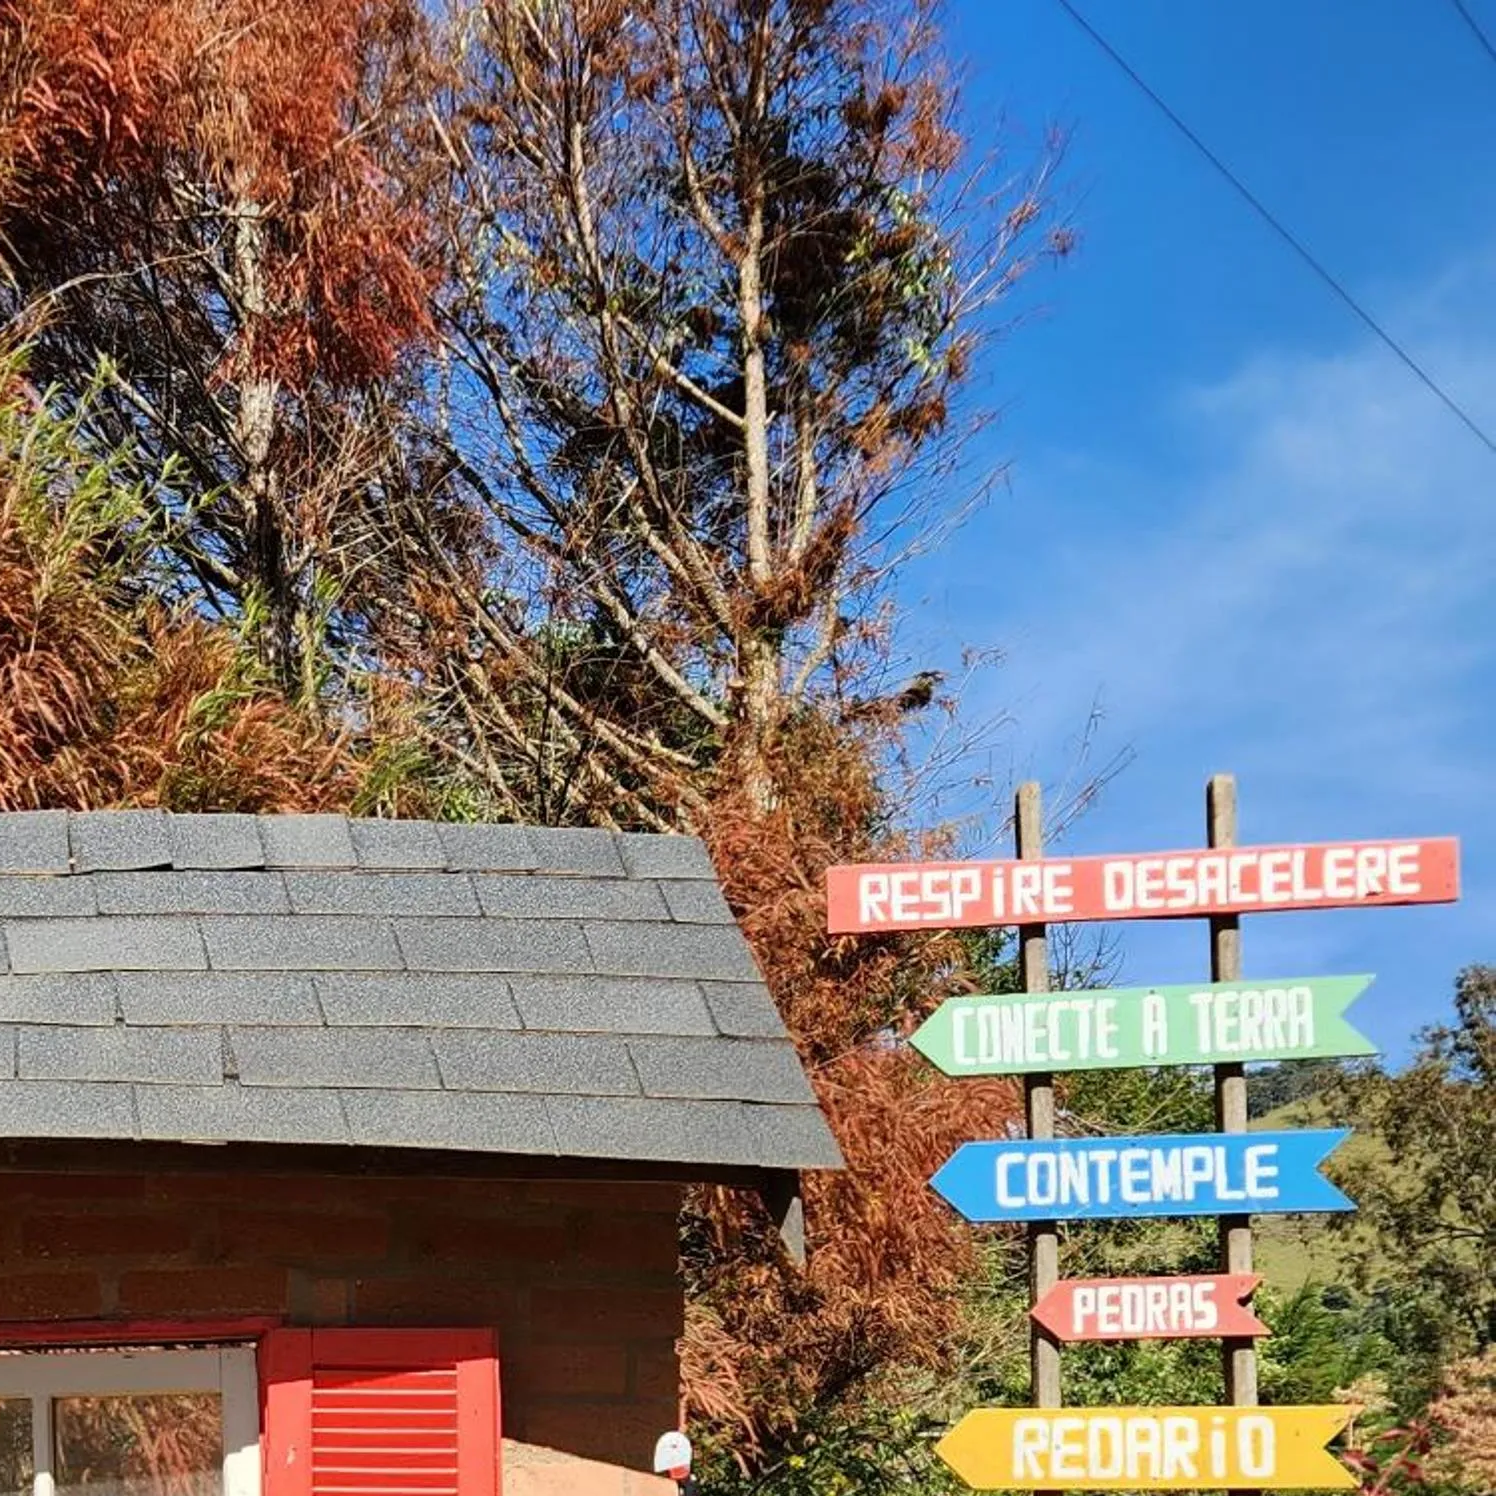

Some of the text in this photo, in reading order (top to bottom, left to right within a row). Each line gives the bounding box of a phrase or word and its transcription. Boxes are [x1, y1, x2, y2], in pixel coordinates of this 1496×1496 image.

[1105, 844, 1421, 911] DESACELERE
[951, 997, 1119, 1067] CONECTE
[1190, 985, 1315, 1053] TERRA
[995, 1144, 1280, 1208] CONTEMPLE
[1072, 1282, 1218, 1334] PEDRAS
